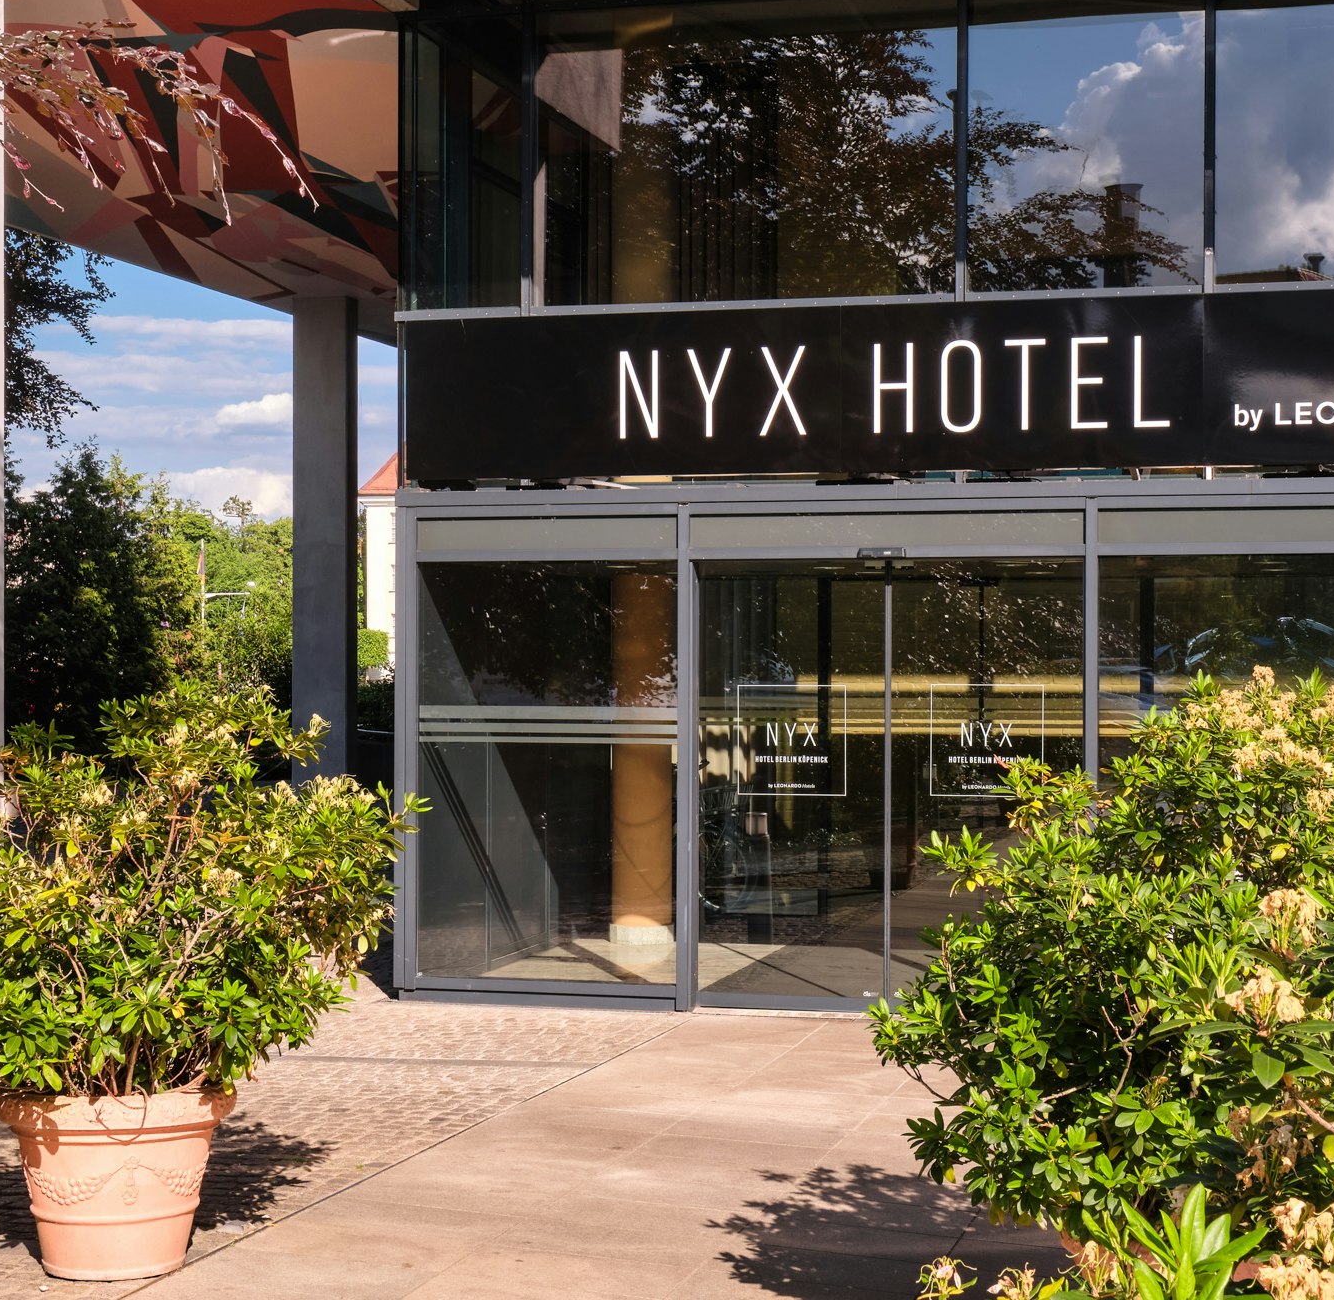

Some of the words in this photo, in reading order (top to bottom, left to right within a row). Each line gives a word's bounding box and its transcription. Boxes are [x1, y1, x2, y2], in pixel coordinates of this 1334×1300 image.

[619, 345, 807, 440] NYX
[873, 335, 1171, 434] HOTEL
[1234, 403, 1264, 432] by
[766, 722, 817, 747] NYX
[960, 722, 1013, 748] NYX
[755, 755, 774, 763] HOTEL
[775, 755, 797, 763] BERLIN
[798, 755, 829, 763] KÖPENICK
[948, 755, 968, 764] HOTEL
[969, 755, 992, 764] BERLIN
